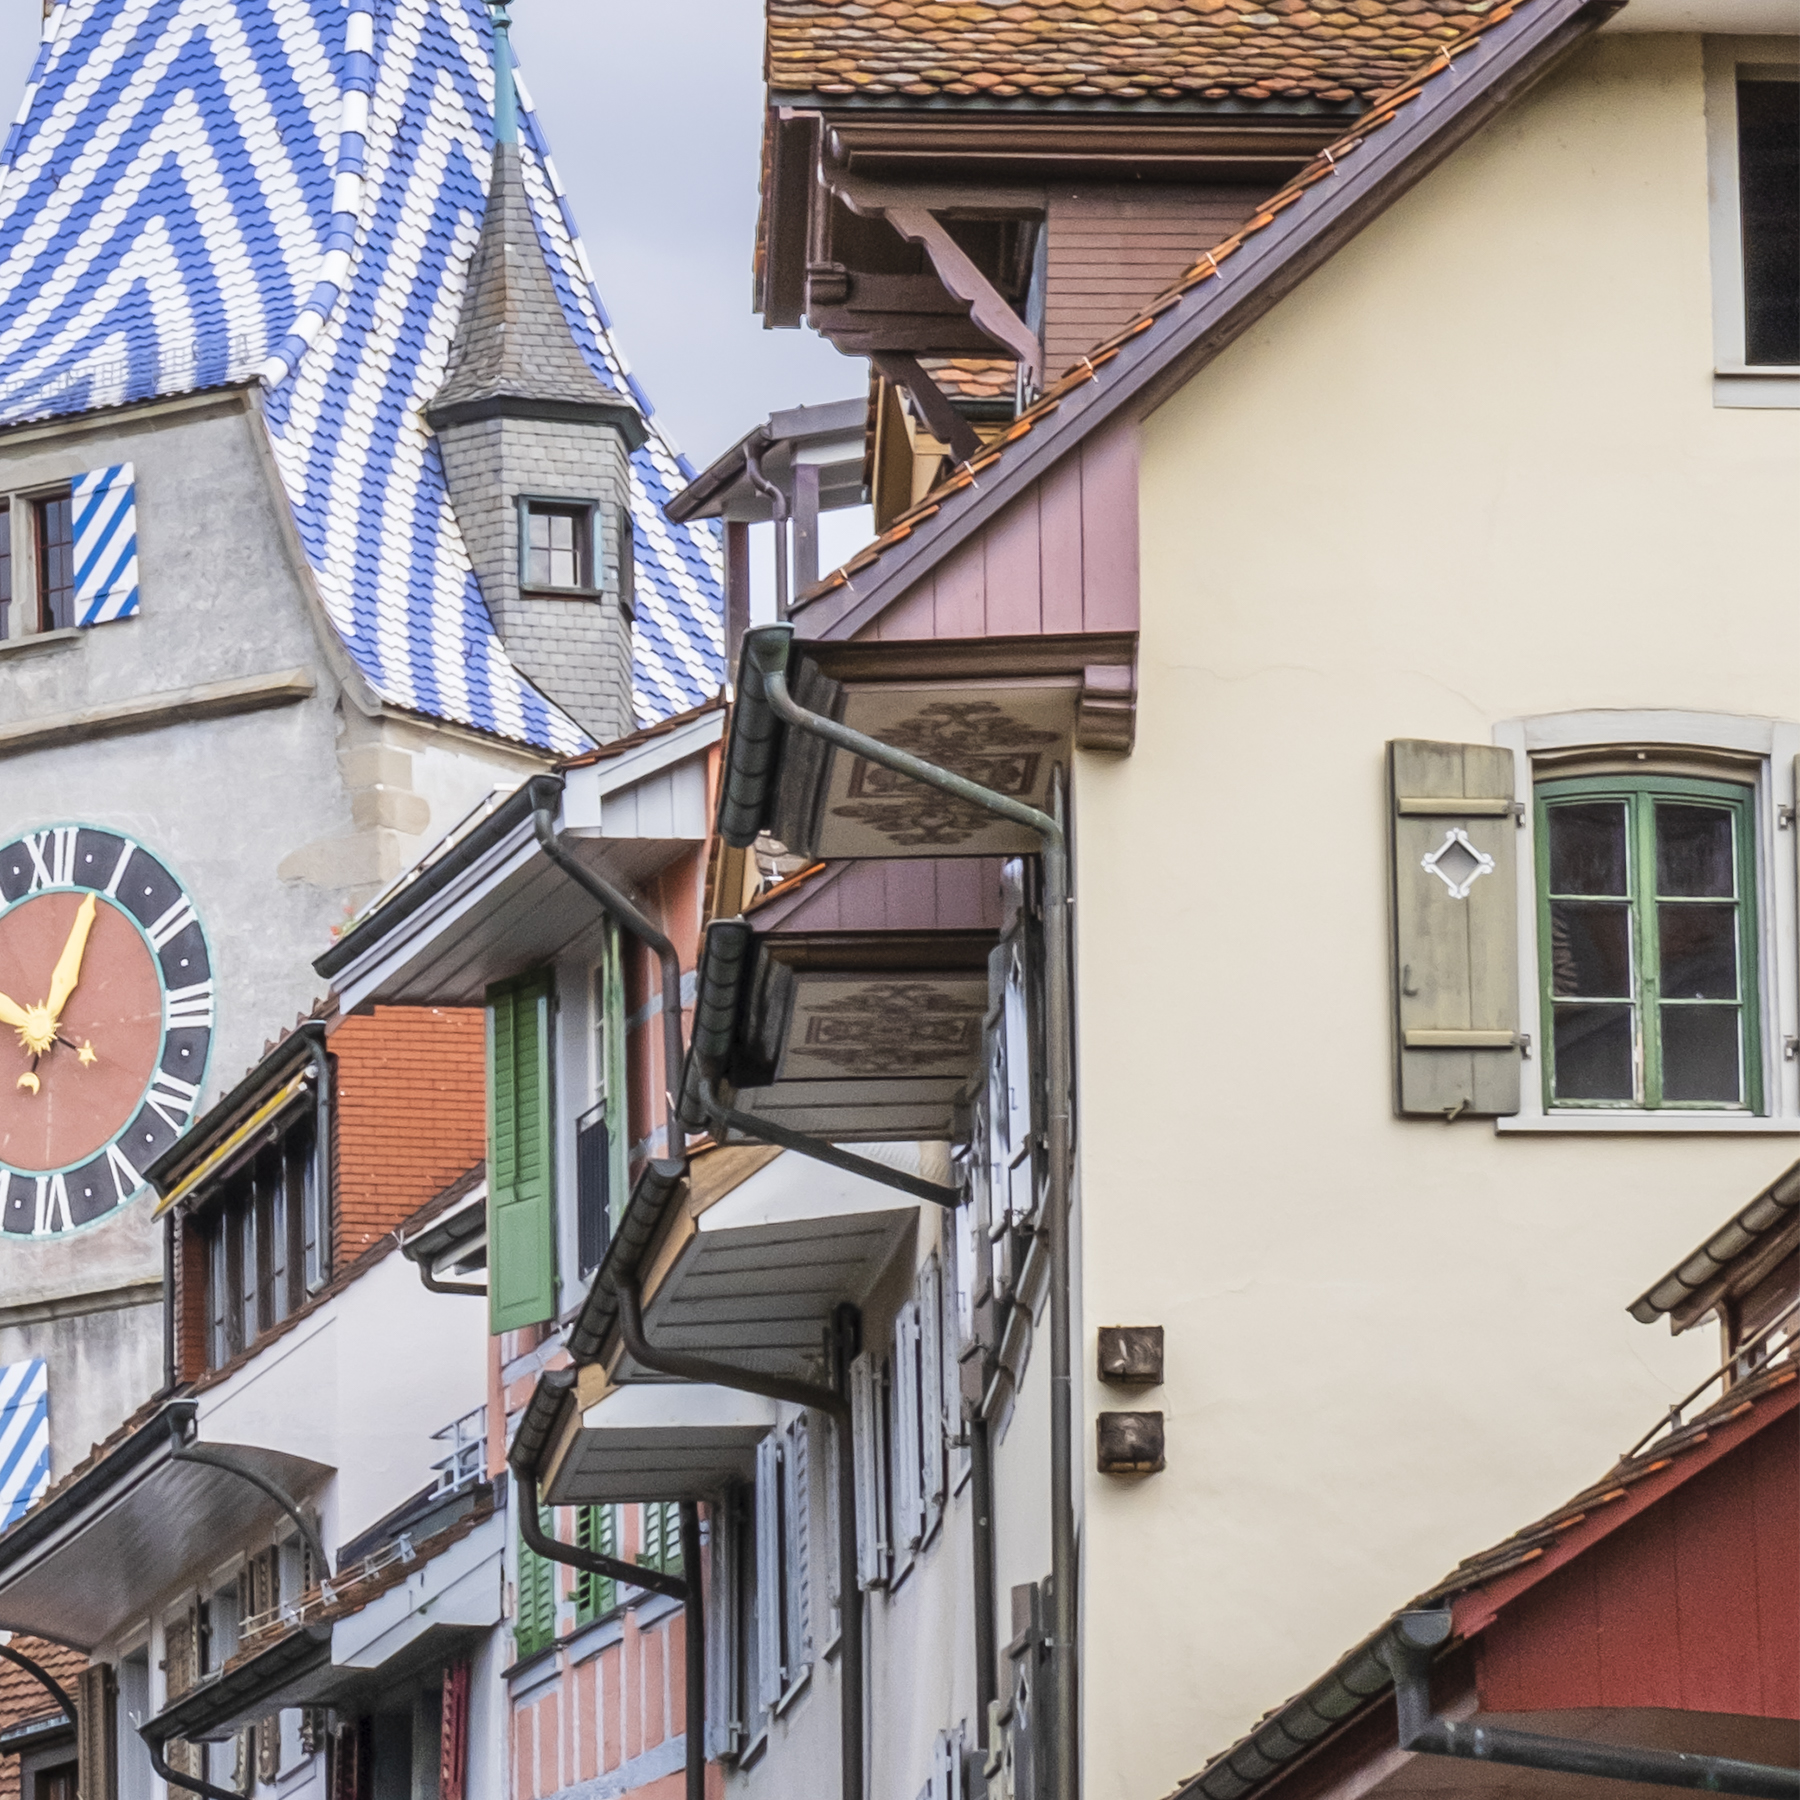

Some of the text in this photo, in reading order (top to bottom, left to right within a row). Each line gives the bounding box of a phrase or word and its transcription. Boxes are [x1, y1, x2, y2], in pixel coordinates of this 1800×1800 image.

[22, 826, 79, 894] XII
[145, 892, 199, 954] II
[165, 978, 213, 1032] III
[145, 1067, 201, 1138] IV
